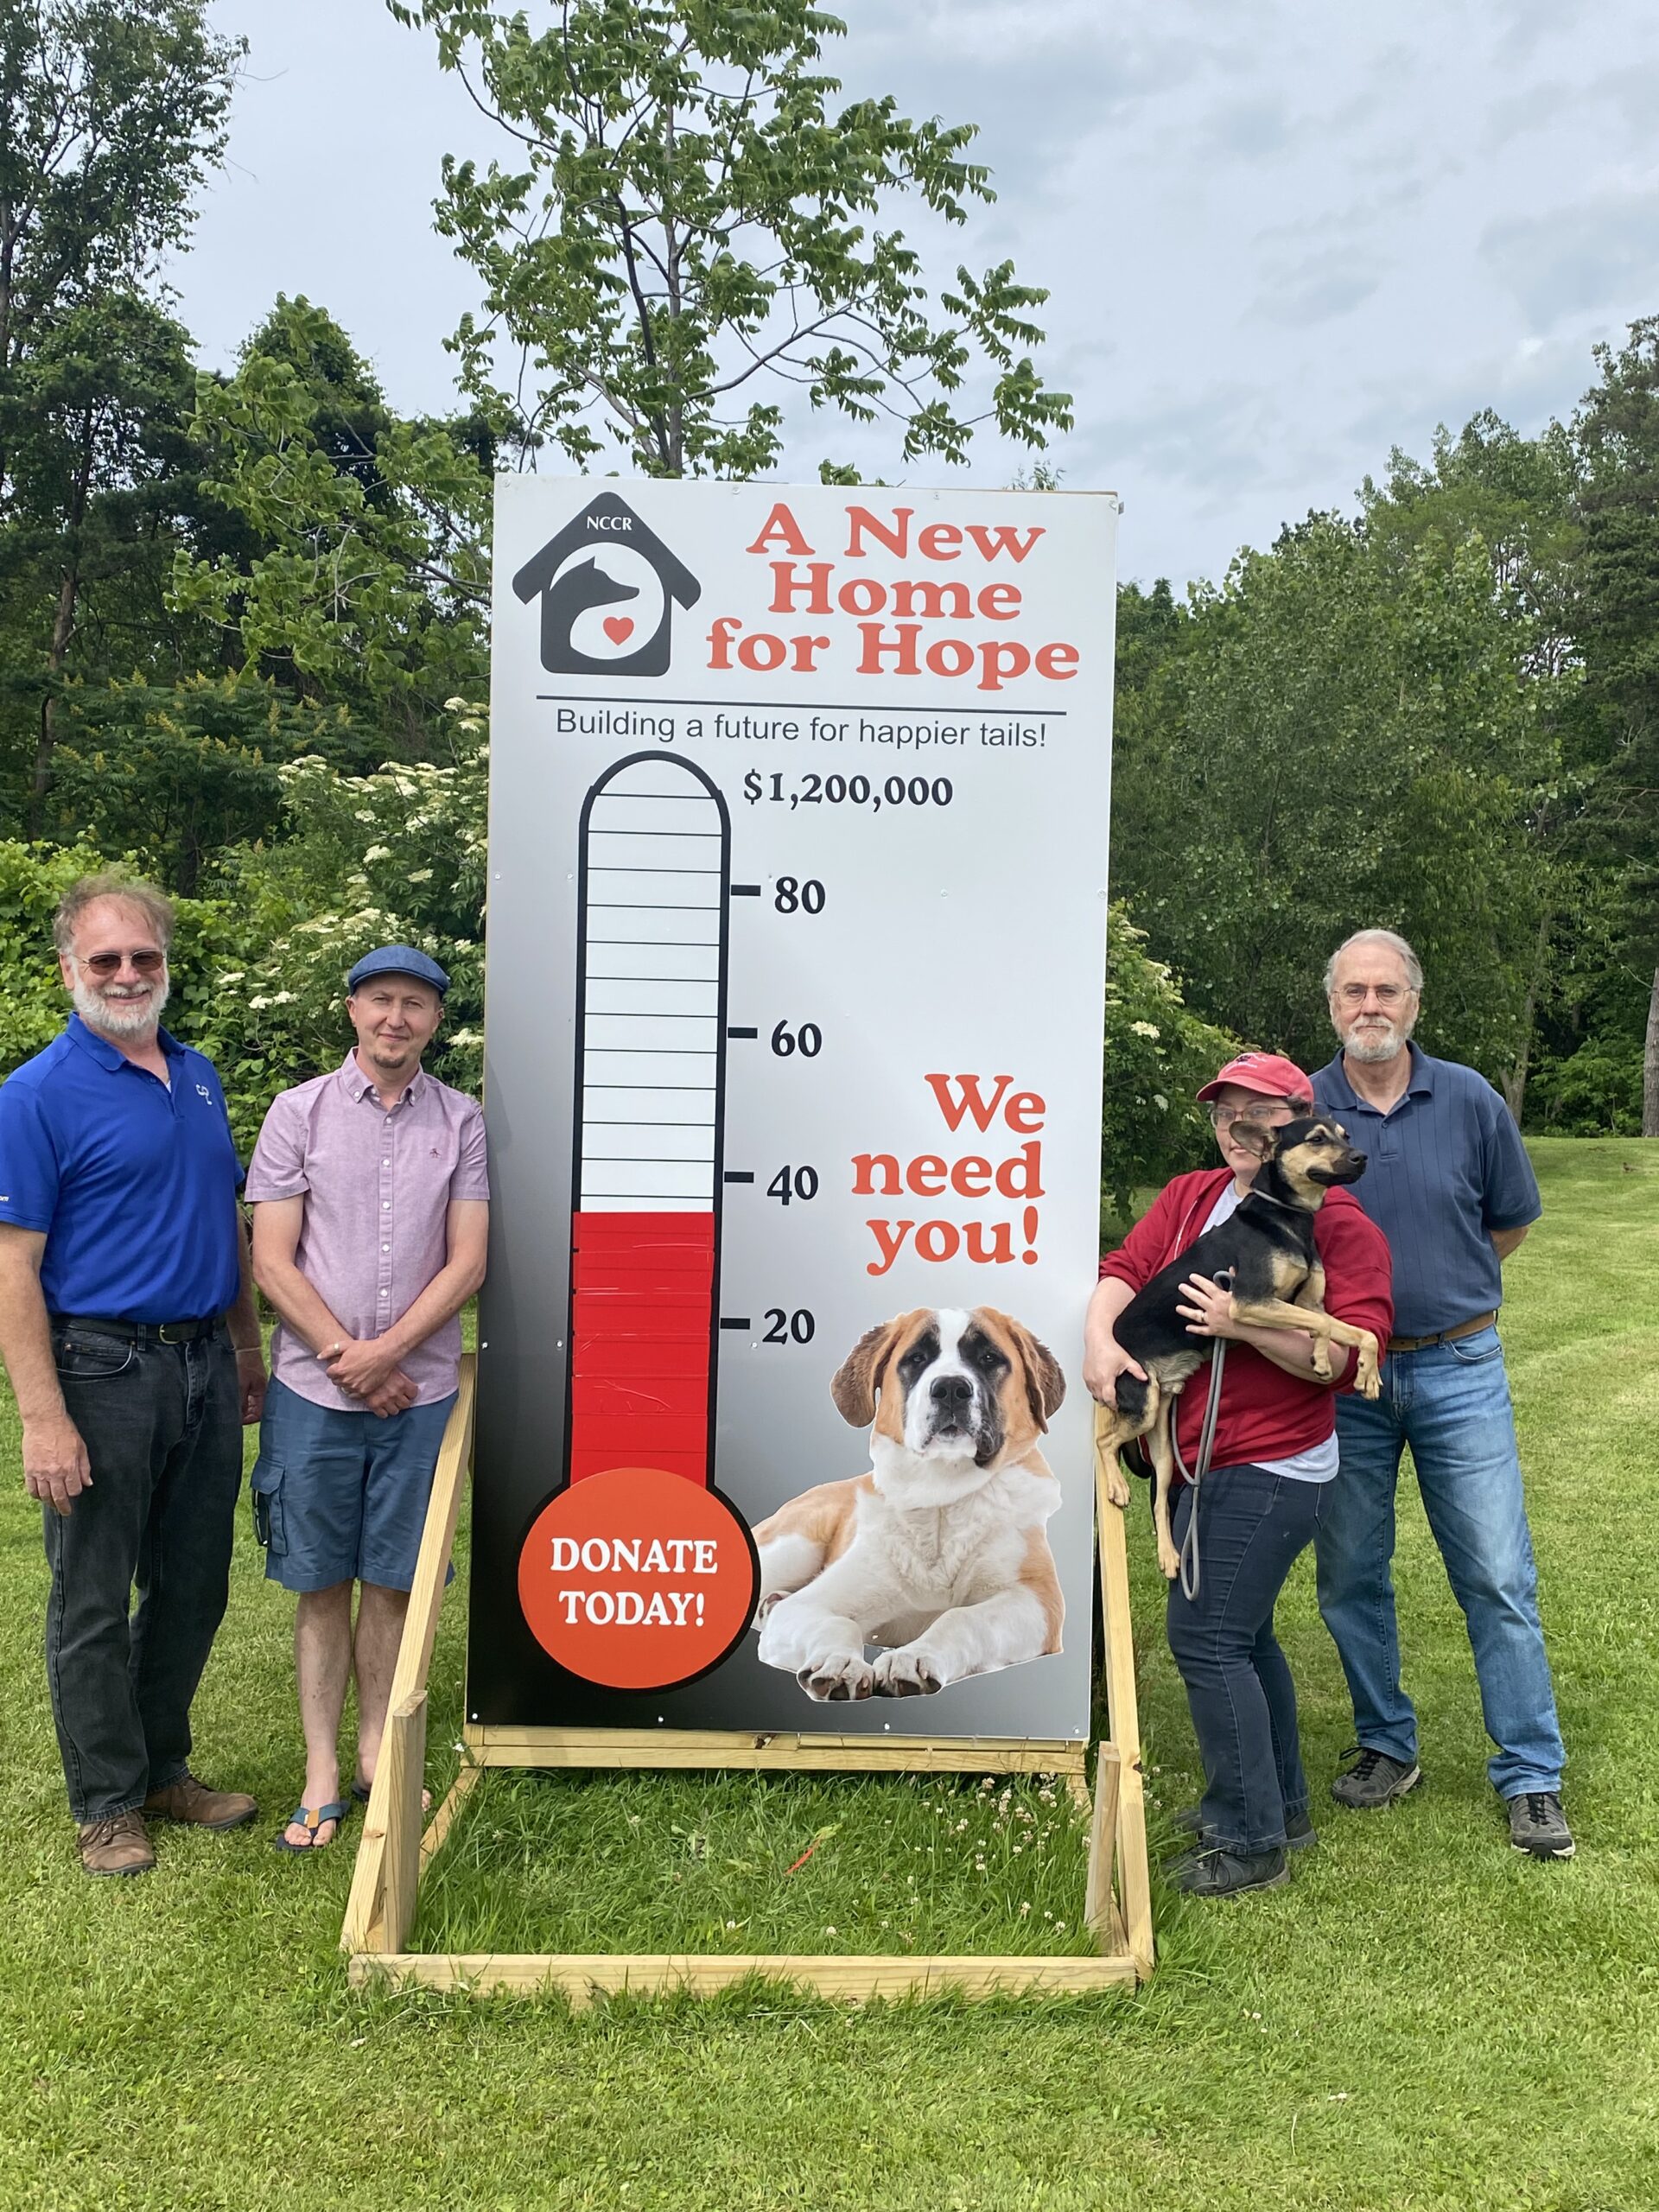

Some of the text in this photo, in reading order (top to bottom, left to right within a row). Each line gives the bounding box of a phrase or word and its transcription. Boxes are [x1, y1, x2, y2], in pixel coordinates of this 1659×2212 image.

[587, 515, 632, 531] NCCR
[746, 503, 1046, 563] A New
[768, 562, 1022, 621] Home
[706, 617, 1078, 690] for Hope
[557, 709, 1045, 749] Building a future for happier tails!
[744, 769, 952, 812] $1,200,000
[775, 877, 825, 914] 80
[772, 1020, 822, 1057] 60
[925, 1074, 1046, 1134] We
[767, 1166, 818, 1205] 40
[852, 1141, 1045, 1198] need
[867, 1206, 1038, 1275] you!
[762, 1309, 815, 1344] 20
[550, 1538, 717, 1573] DONATE
[559, 1591, 704, 1626] TODAY!
